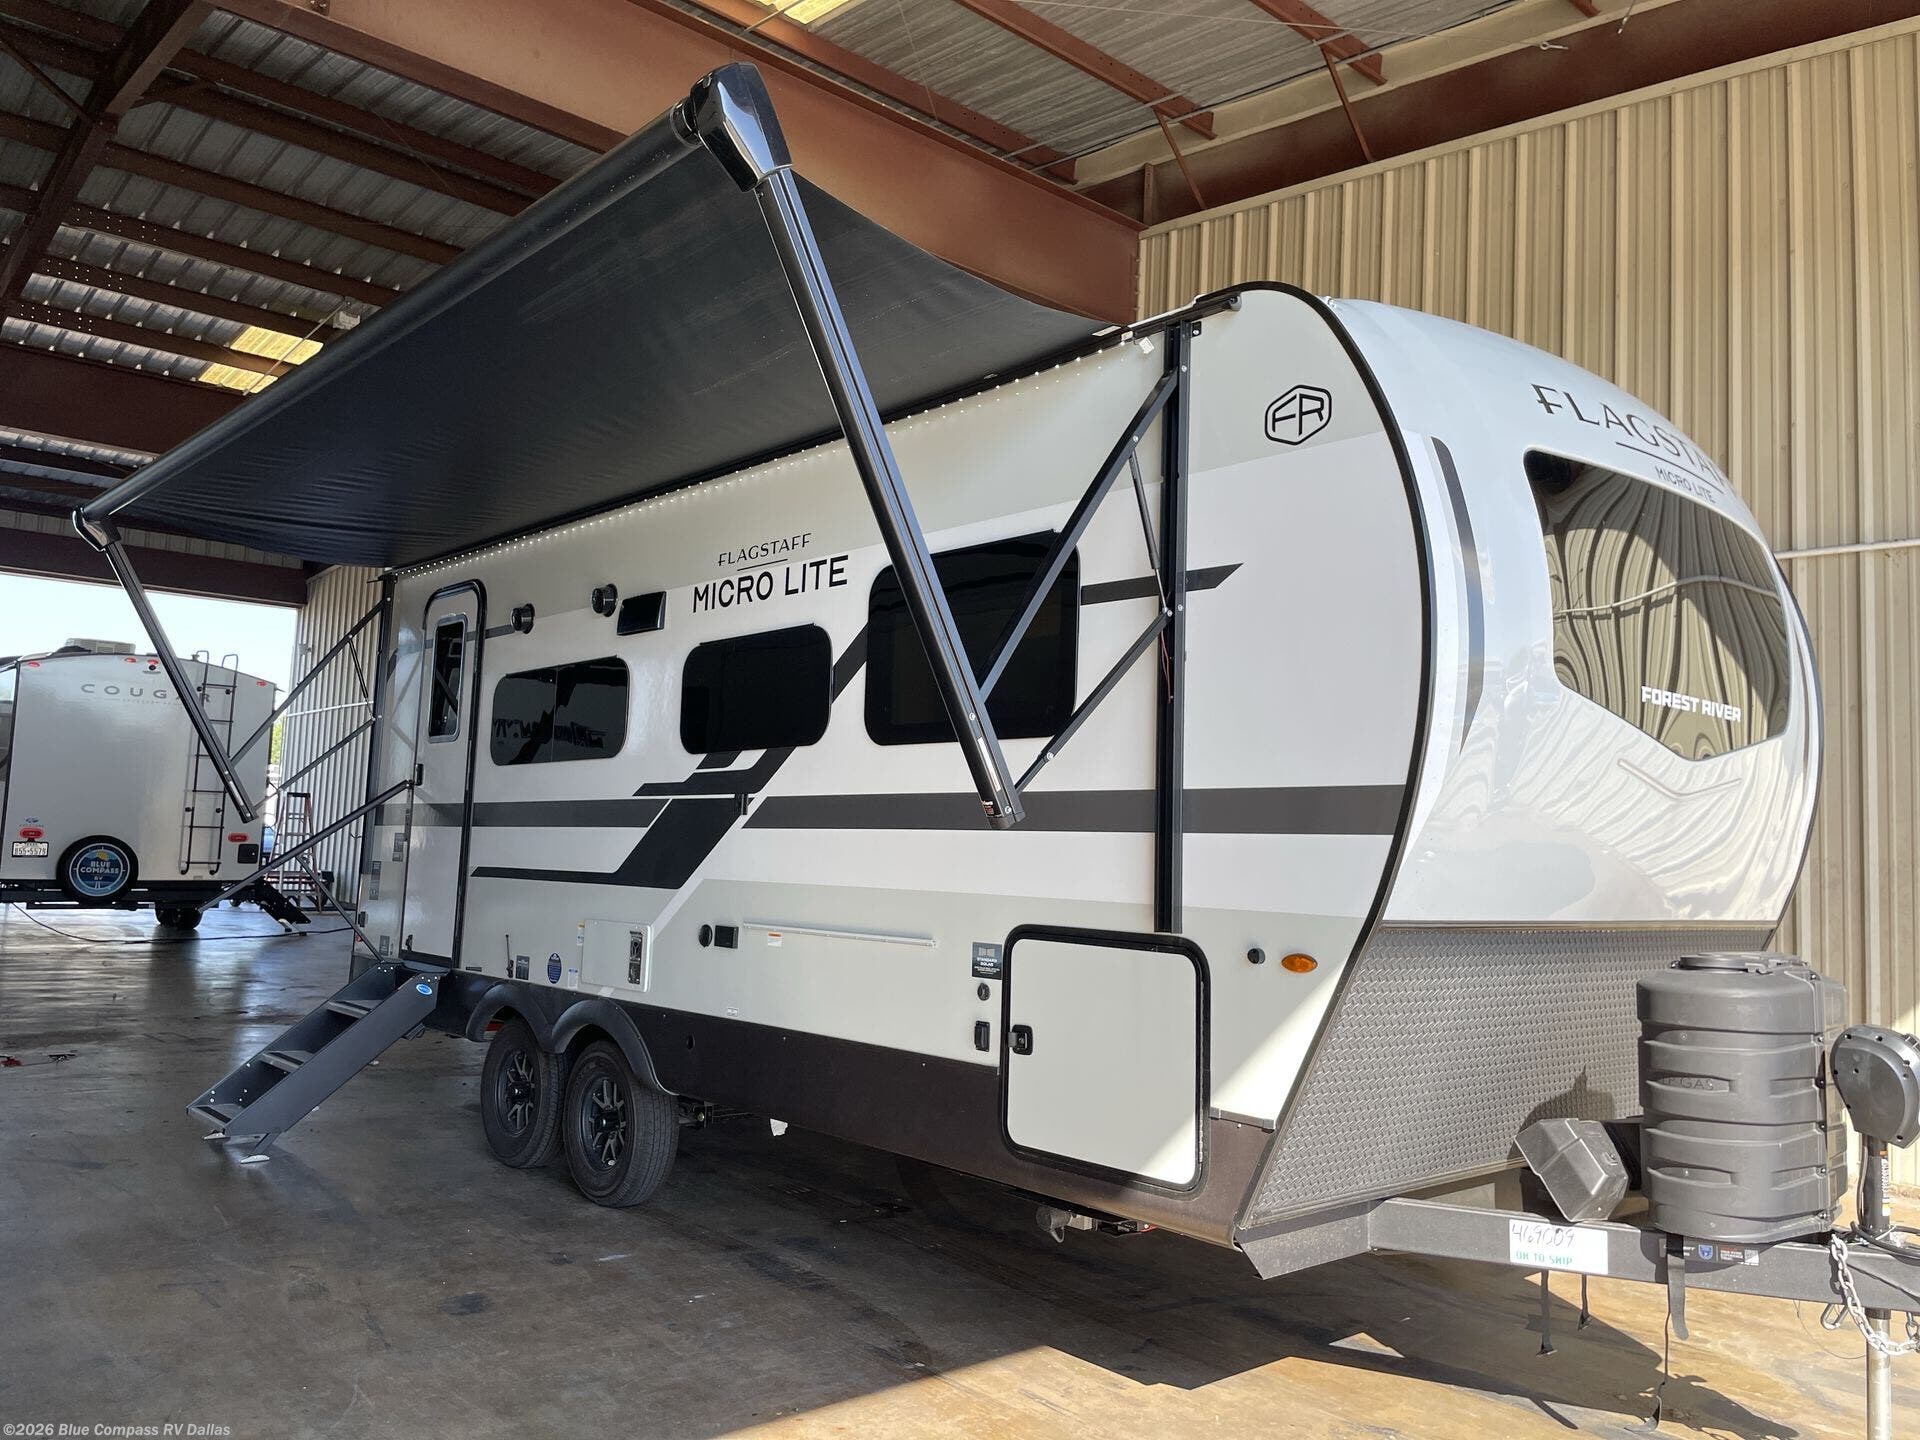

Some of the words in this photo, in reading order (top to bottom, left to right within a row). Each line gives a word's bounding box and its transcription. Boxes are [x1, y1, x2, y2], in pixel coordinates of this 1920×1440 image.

[1654, 466, 1692, 492] MICRO
[1692, 482, 1716, 504] LITE
[717, 533, 812, 567] FLAGSTAFF
[693, 571, 774, 614] MICRO
[784, 555, 849, 596] LITE
[81, 684, 210, 702] COUGR
[1641, 685, 1700, 713] FOREST
[1701, 699, 1742, 723] RIVER
[1680, 1077, 1714, 1091] GAS
[1516, 1250, 1529, 1260] OK
[1534, 1252, 1545, 1263] TO
[1549, 1255, 1573, 1266] SHIP
